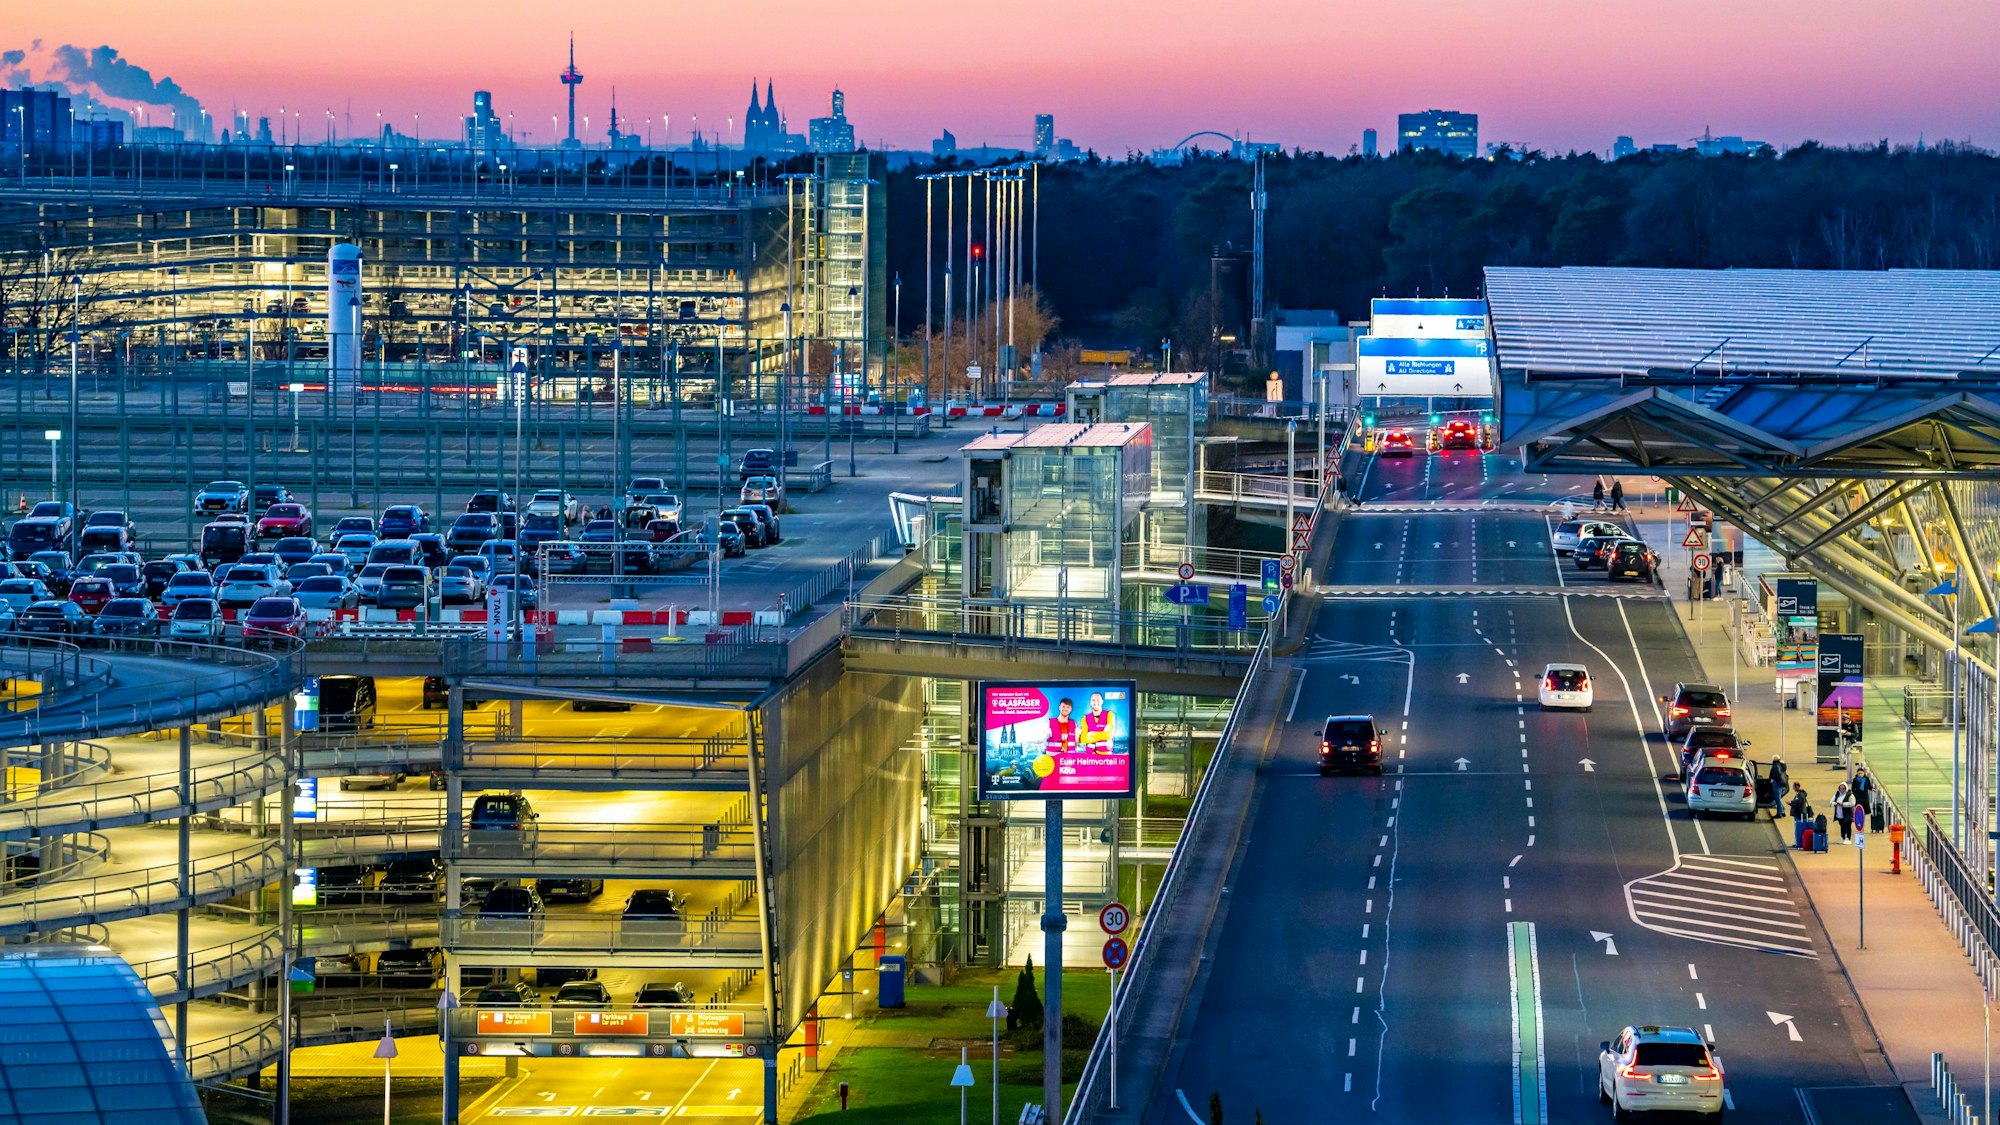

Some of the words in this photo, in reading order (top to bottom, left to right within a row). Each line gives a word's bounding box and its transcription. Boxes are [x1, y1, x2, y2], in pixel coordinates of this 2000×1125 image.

[1282, 558, 1292, 566] 30
[1697, 558, 1706, 566] 30
[1180, 586, 1190, 603] P
[493, 598, 501, 625] TANK
[312, 679, 318, 688] 5
[998, 699, 1041, 707] GLASFASER
[1059, 757, 1076, 766] Euer
[1076, 757, 1118, 766] Heimvorteil
[1118, 758, 1126, 766] in
[1059, 766, 1077, 775] Köln
[1106, 911, 1123, 926] 30
[505, 1012, 532, 1020] Parkhaus
[698, 1013, 729, 1022] Mietwagen
[697, 1027, 729, 1036] Carsharing
[749, 1046, 754, 1054] 5
